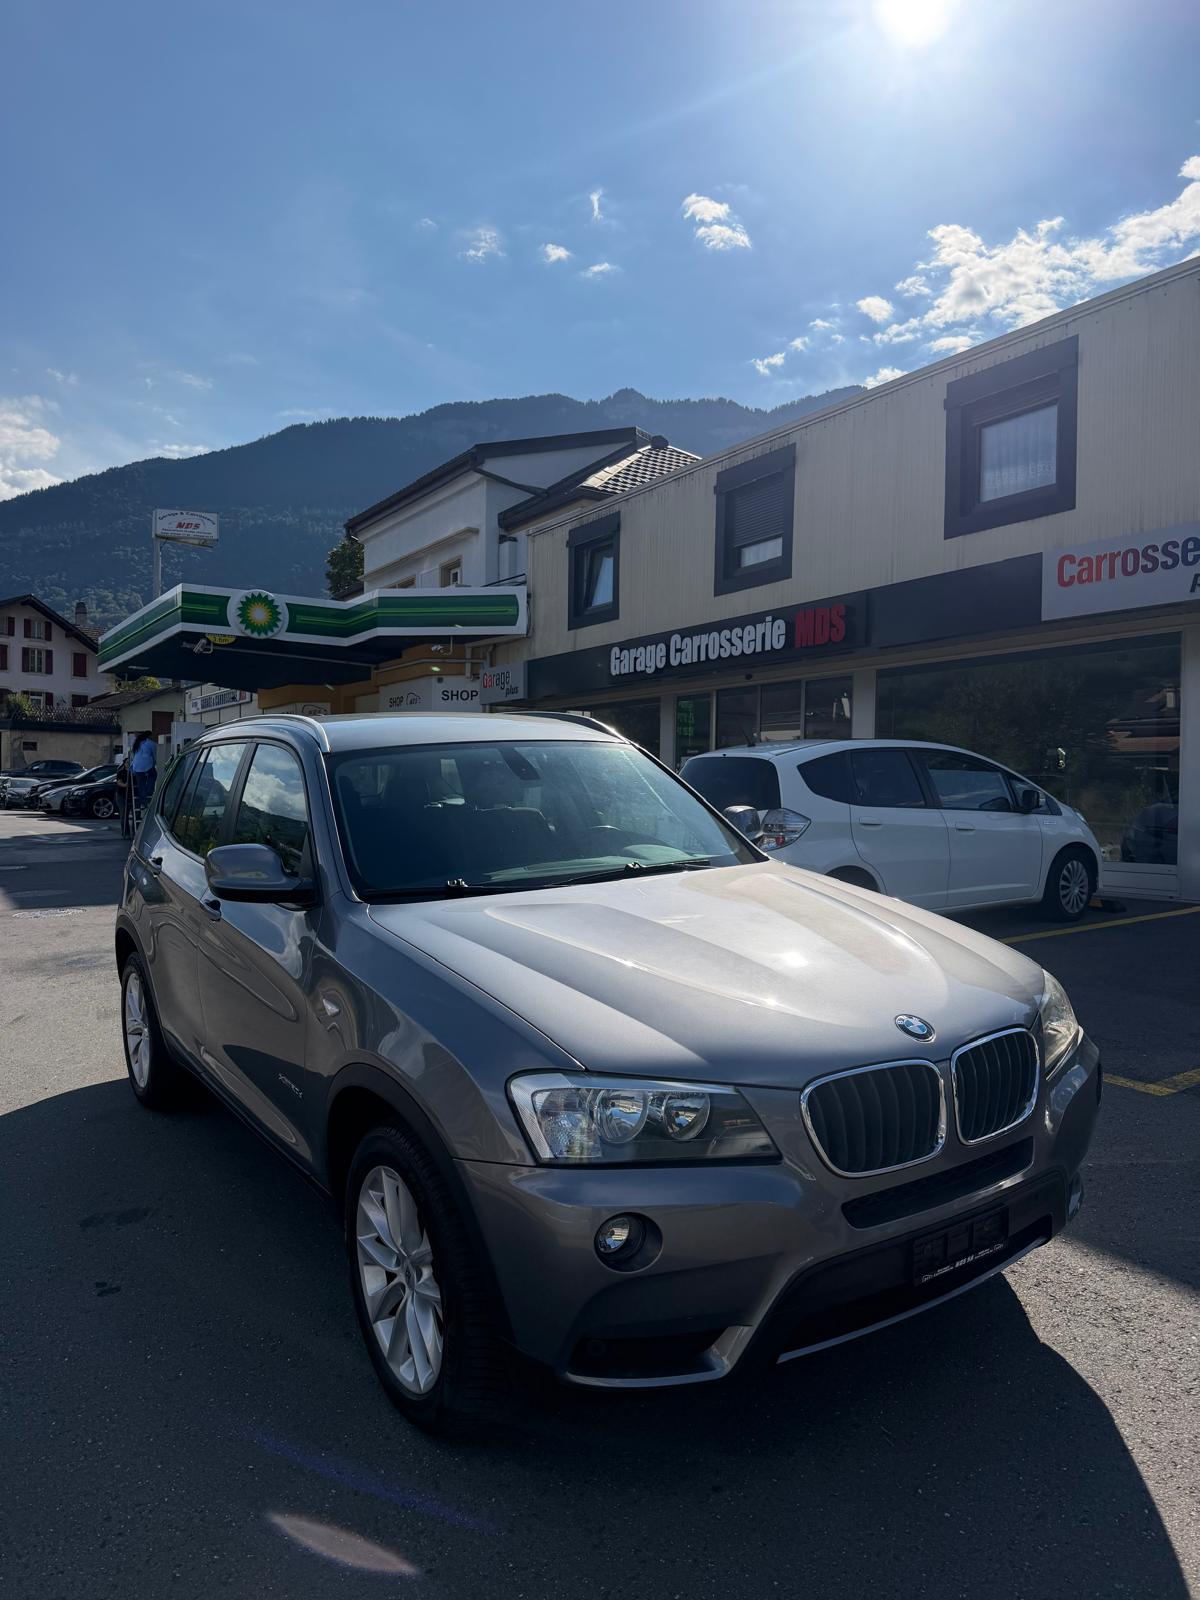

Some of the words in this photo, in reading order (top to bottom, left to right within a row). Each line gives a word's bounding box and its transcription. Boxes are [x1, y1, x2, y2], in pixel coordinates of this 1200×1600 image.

[1057, 536, 1200, 588] Carrosse
[610, 641, 667, 676] Garage
[669, 616, 786, 667] Carrosserie
[795, 604, 846, 649] MDS
[482, 670, 511, 690] Garage
[441, 689, 479, 701] SHOP
[505, 685, 519, 698] plus
[389, 695, 404, 708] SHOP
